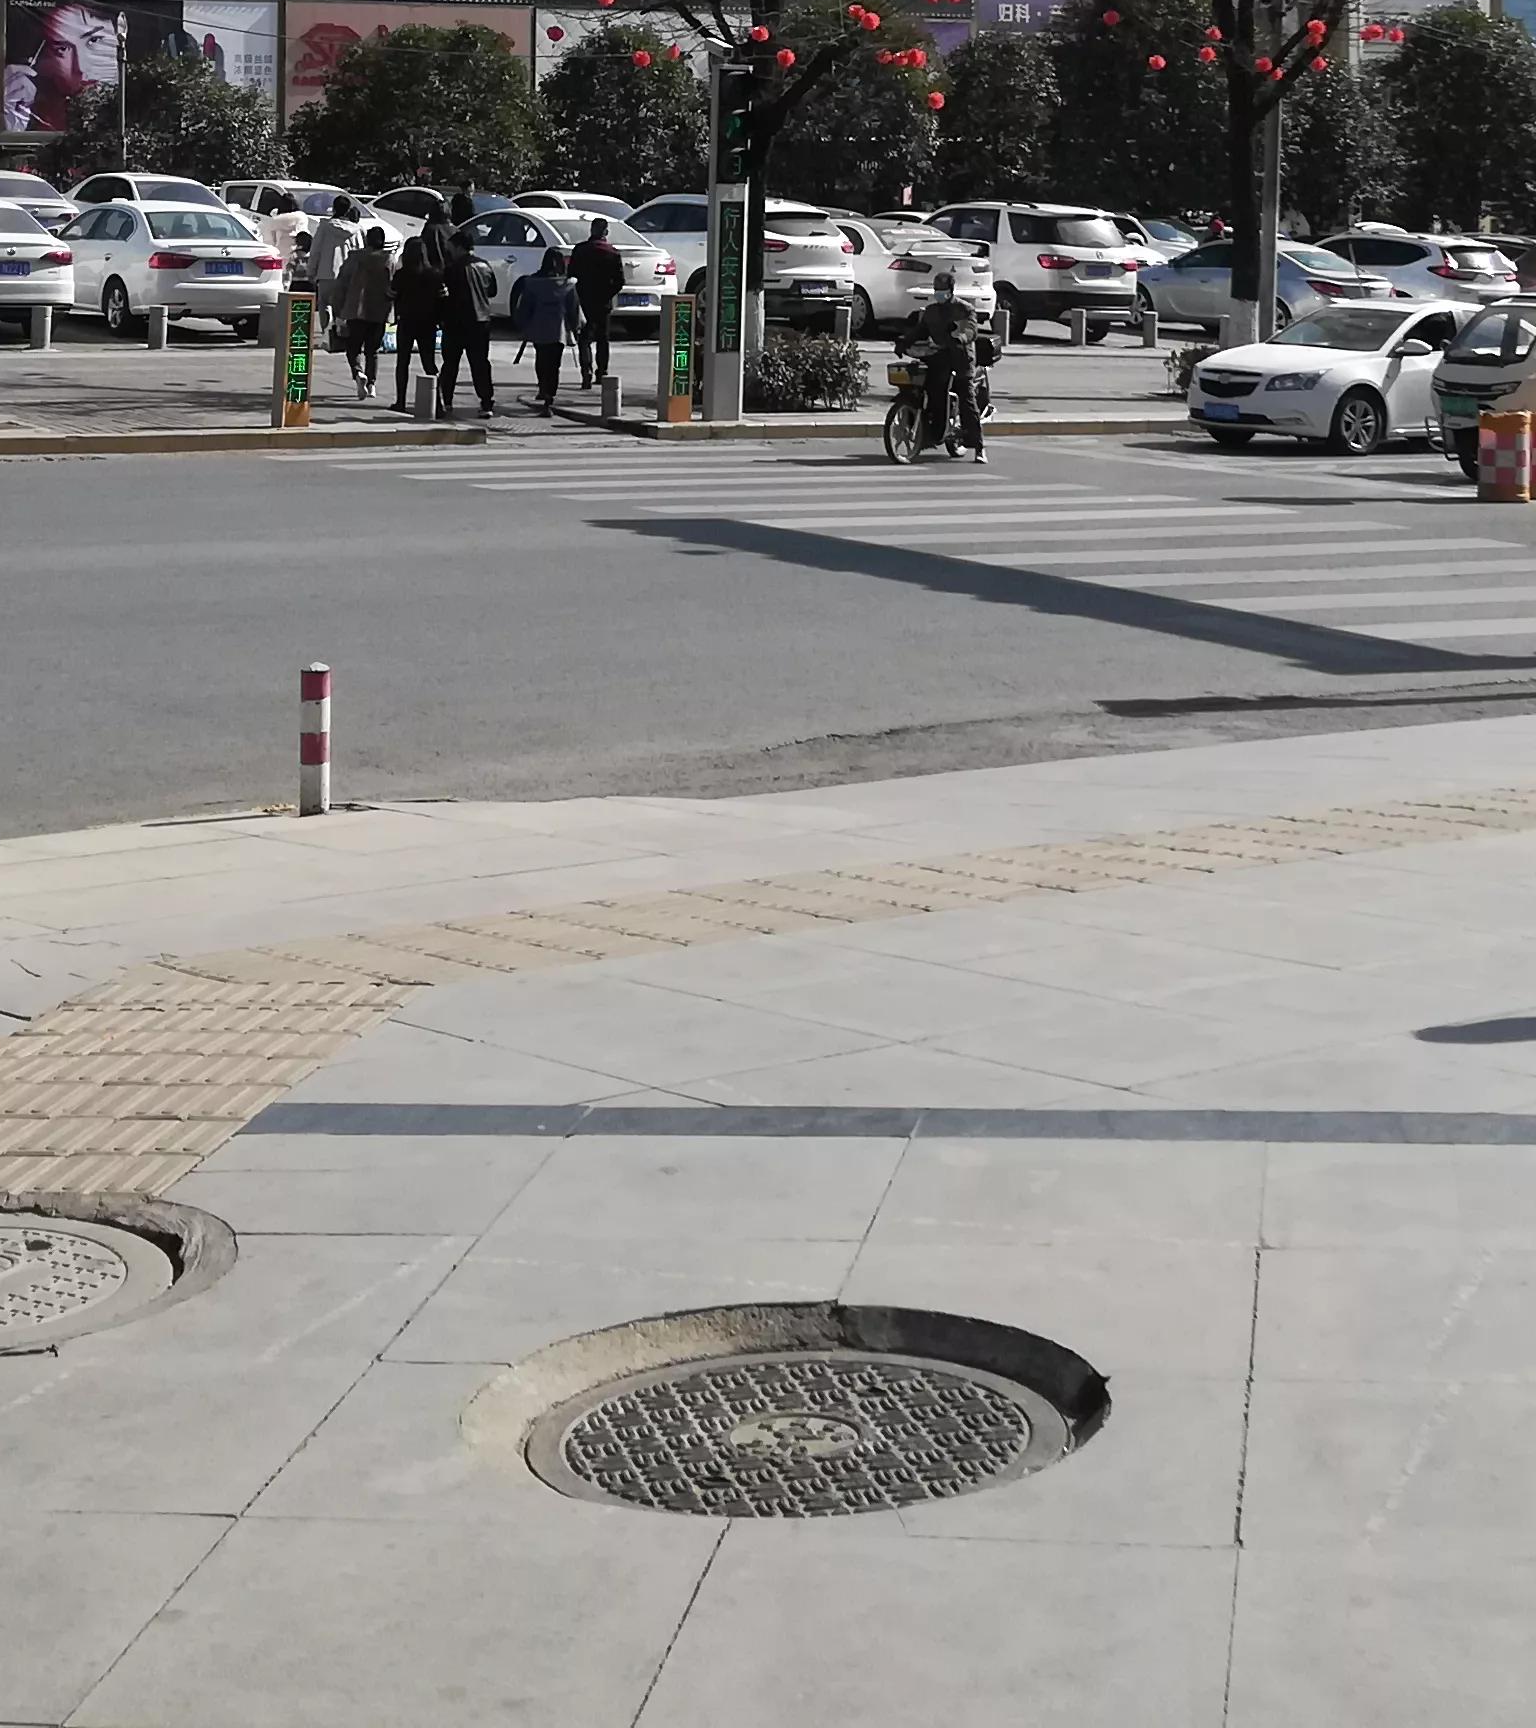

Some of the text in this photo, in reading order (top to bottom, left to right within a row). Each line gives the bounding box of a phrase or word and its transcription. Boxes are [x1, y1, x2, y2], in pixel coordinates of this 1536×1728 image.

[720, 207, 742, 352] 行人安全通行
[287, 301, 312, 404] 安全通行
